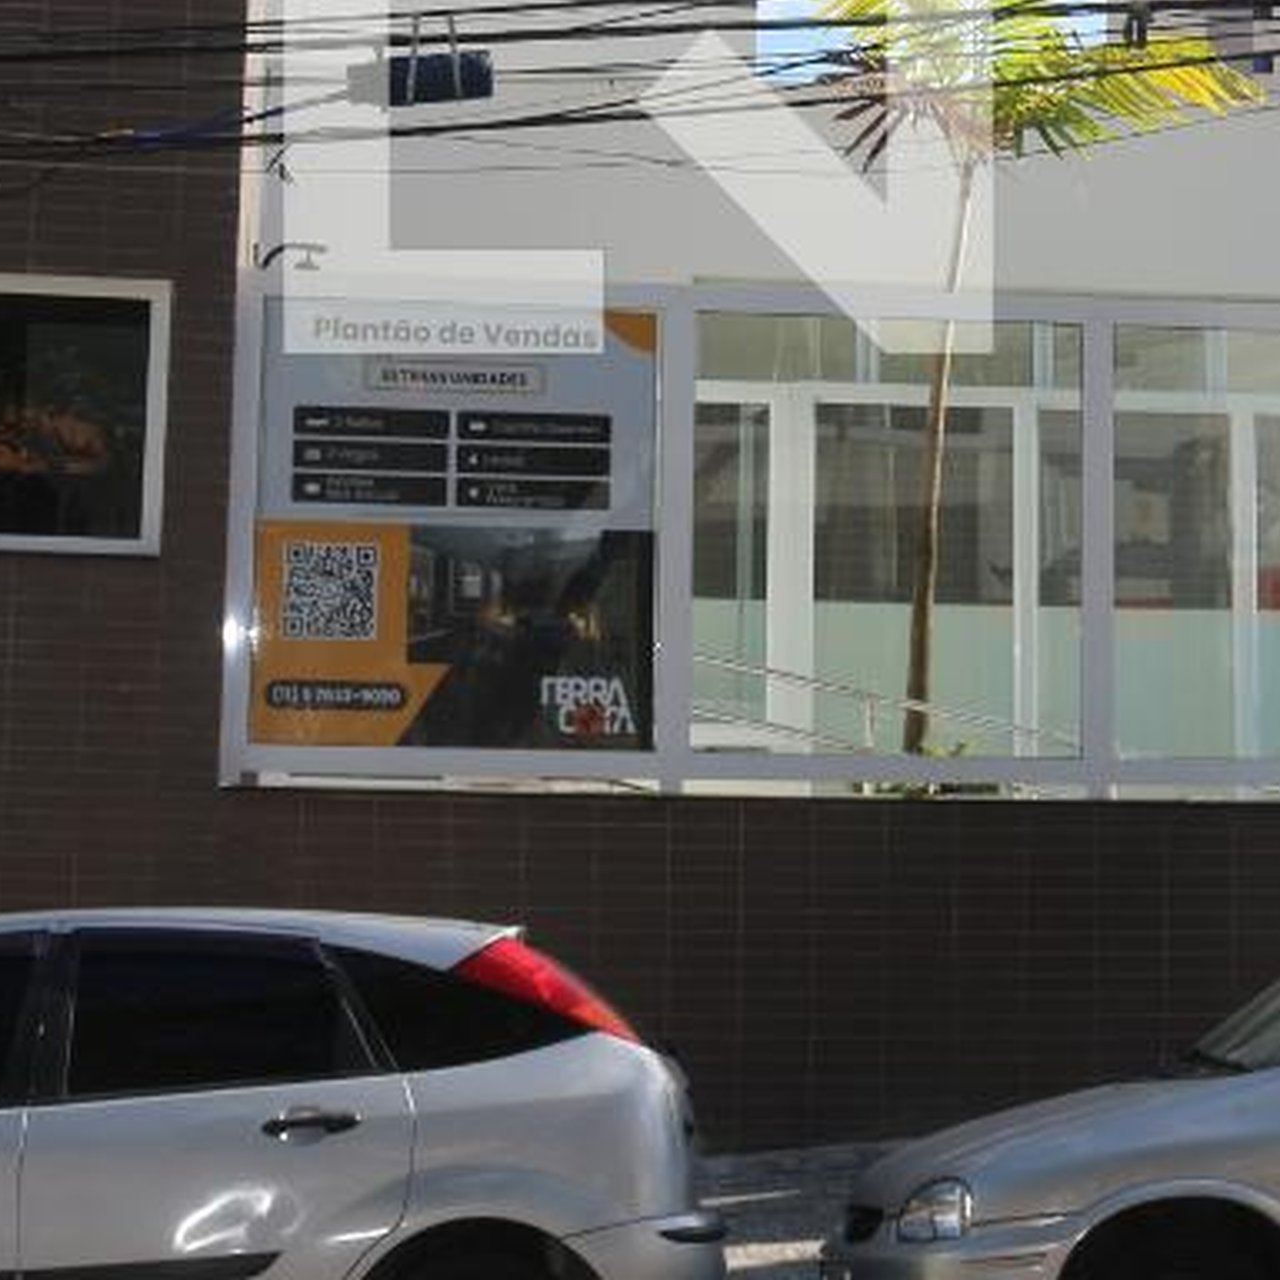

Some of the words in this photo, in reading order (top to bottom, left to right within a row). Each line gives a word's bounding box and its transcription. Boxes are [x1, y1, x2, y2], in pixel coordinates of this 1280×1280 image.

[314, 317, 431, 343] Plantão
[437, 320, 475, 345] de
[482, 322, 598, 349] Vendas
